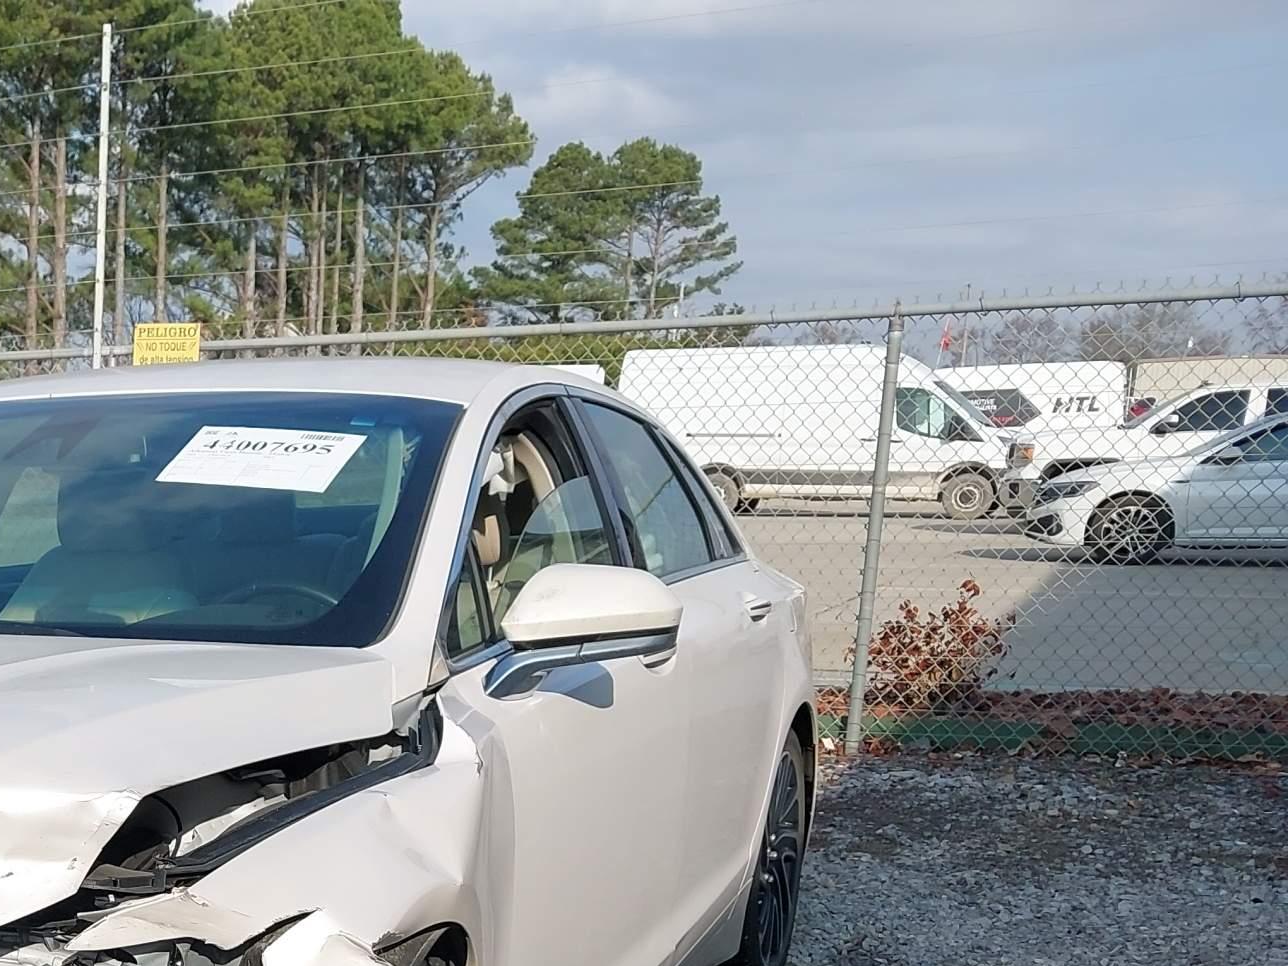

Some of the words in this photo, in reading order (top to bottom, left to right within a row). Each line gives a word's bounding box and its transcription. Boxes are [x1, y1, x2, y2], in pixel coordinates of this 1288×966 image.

[137, 327, 197, 337] PELIGRO
[145, 342, 157, 351] NO
[159, 342, 187, 351] TOQUE
[203, 439, 335, 455] 44007695
